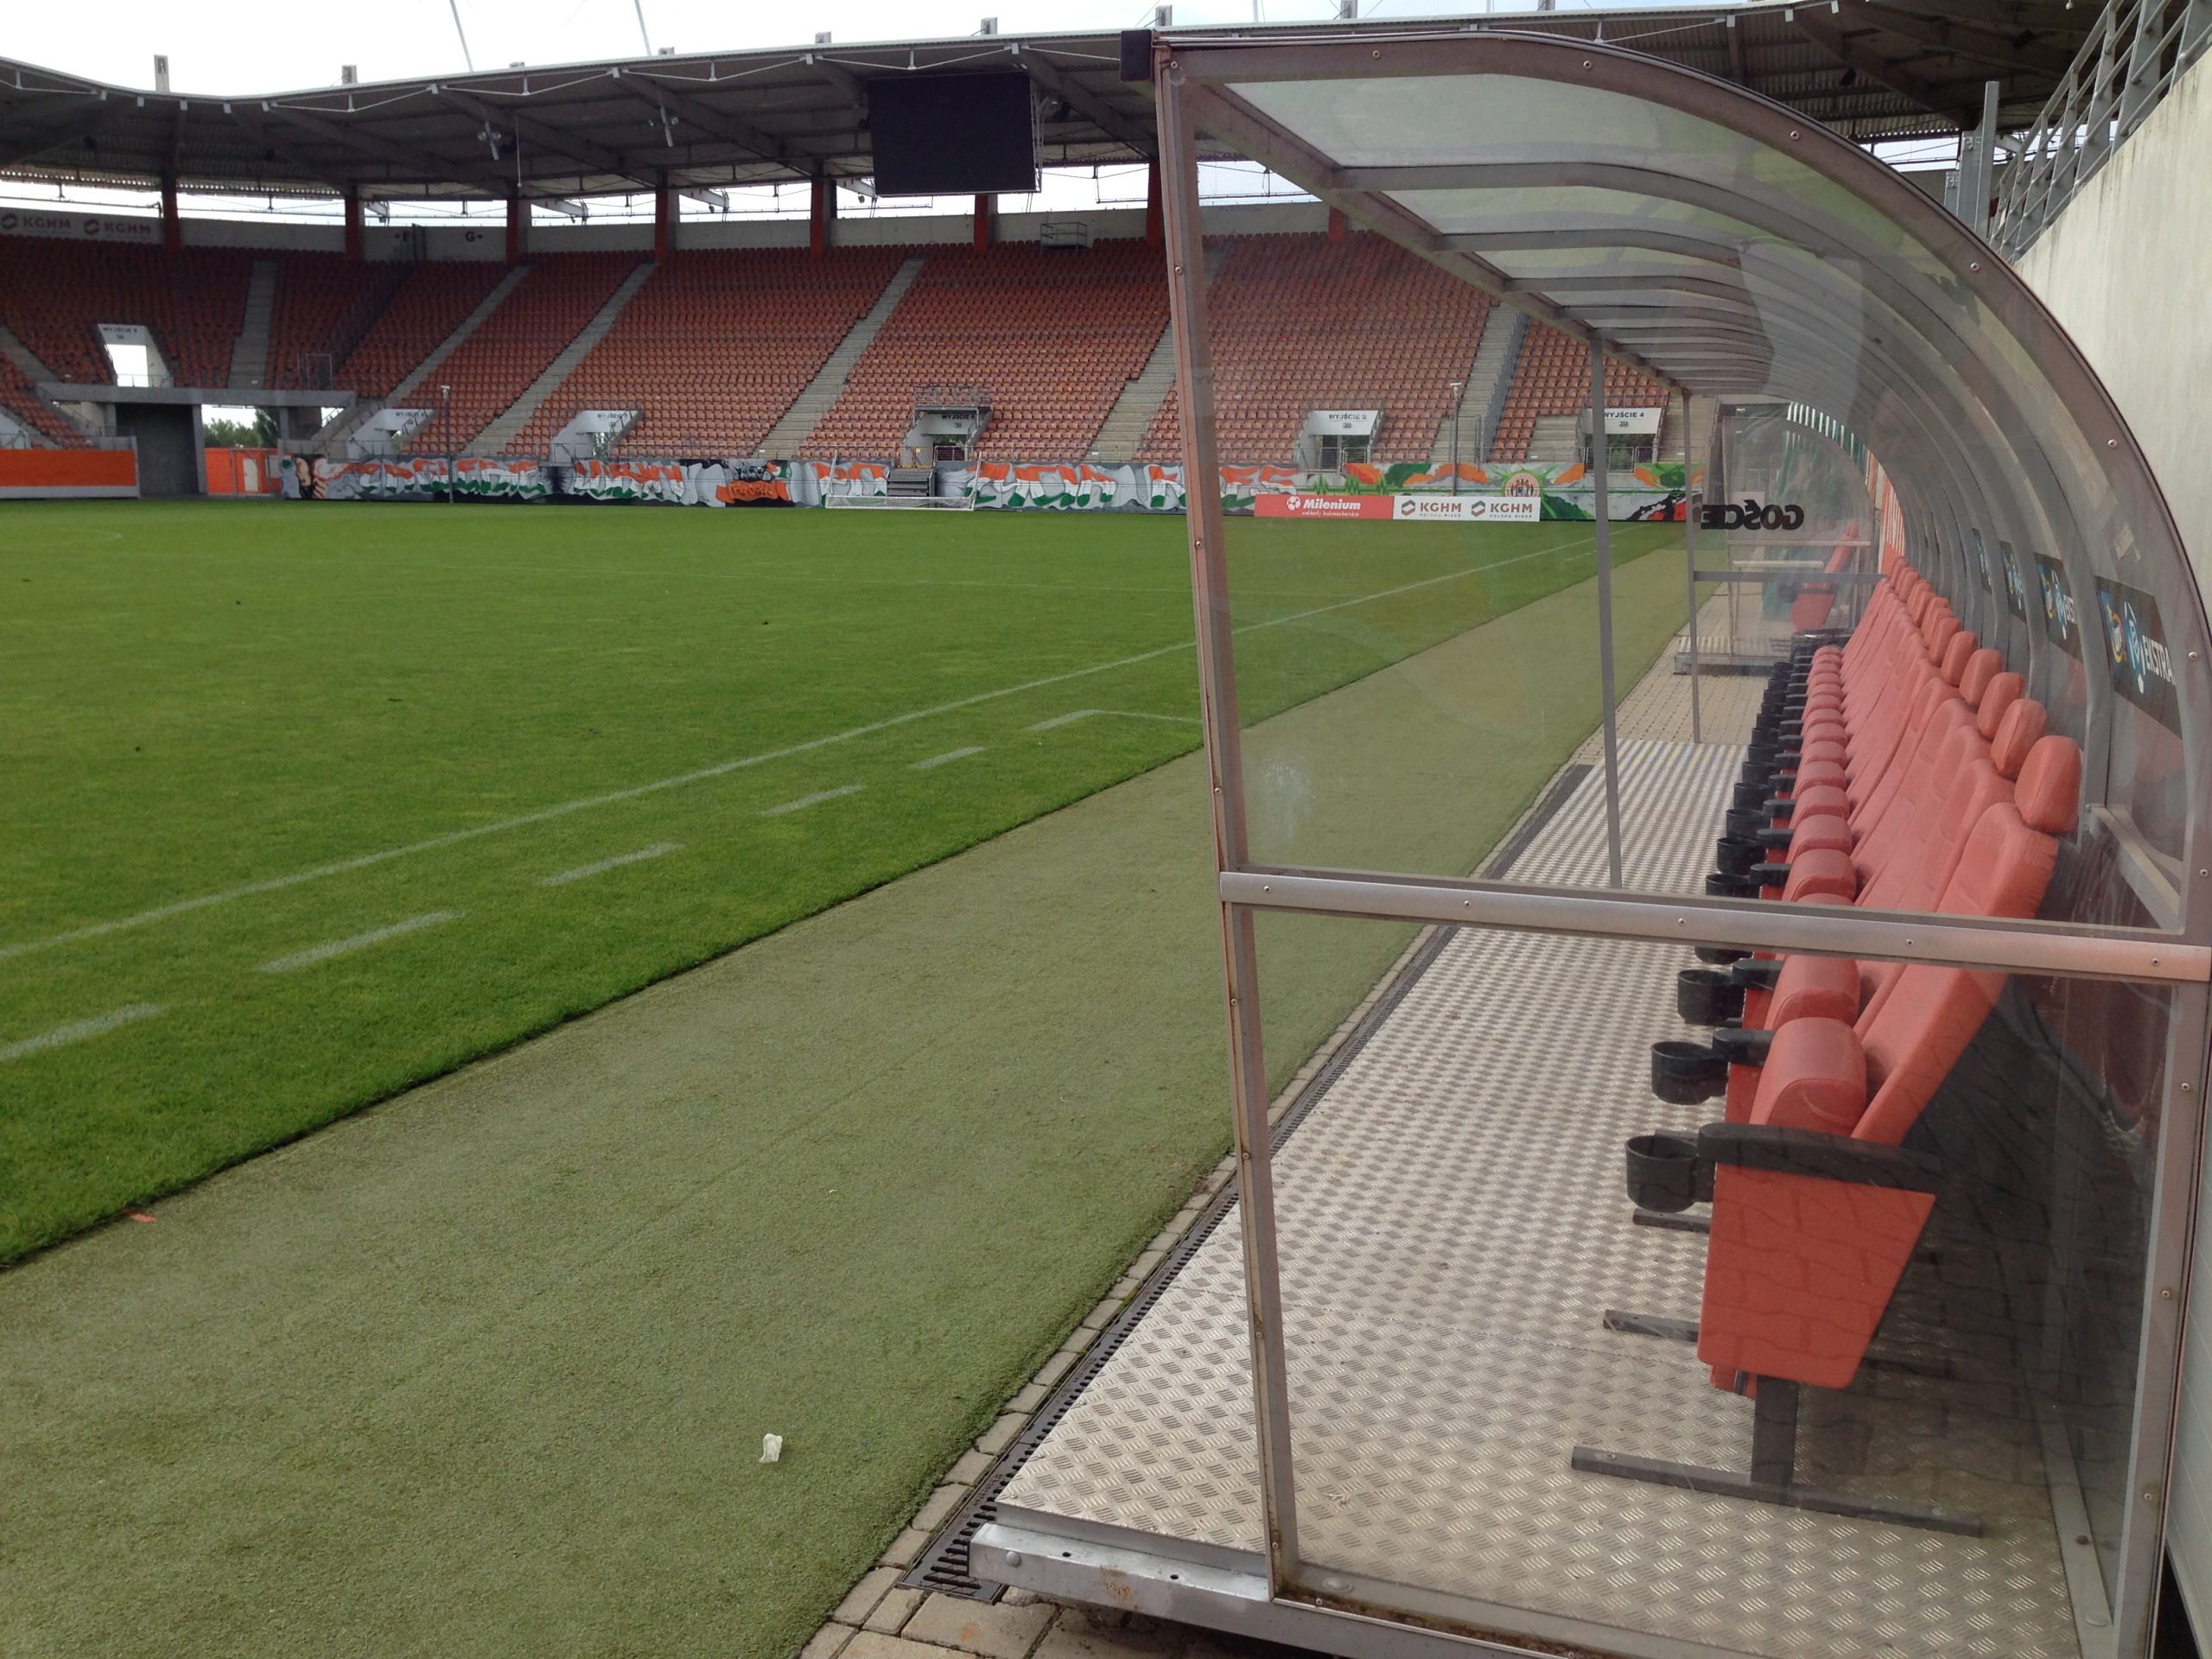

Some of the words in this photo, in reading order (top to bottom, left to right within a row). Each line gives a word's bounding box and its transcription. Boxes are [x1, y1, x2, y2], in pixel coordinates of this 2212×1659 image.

[23, 217, 71, 229] KGHM
[104, 222, 151, 234] KGHM
[465, 231, 476, 242] G
[1303, 499, 1362, 510] Milenium
[1420, 502, 1462, 512] KGHM
[1490, 503, 1533, 513] KGHM
